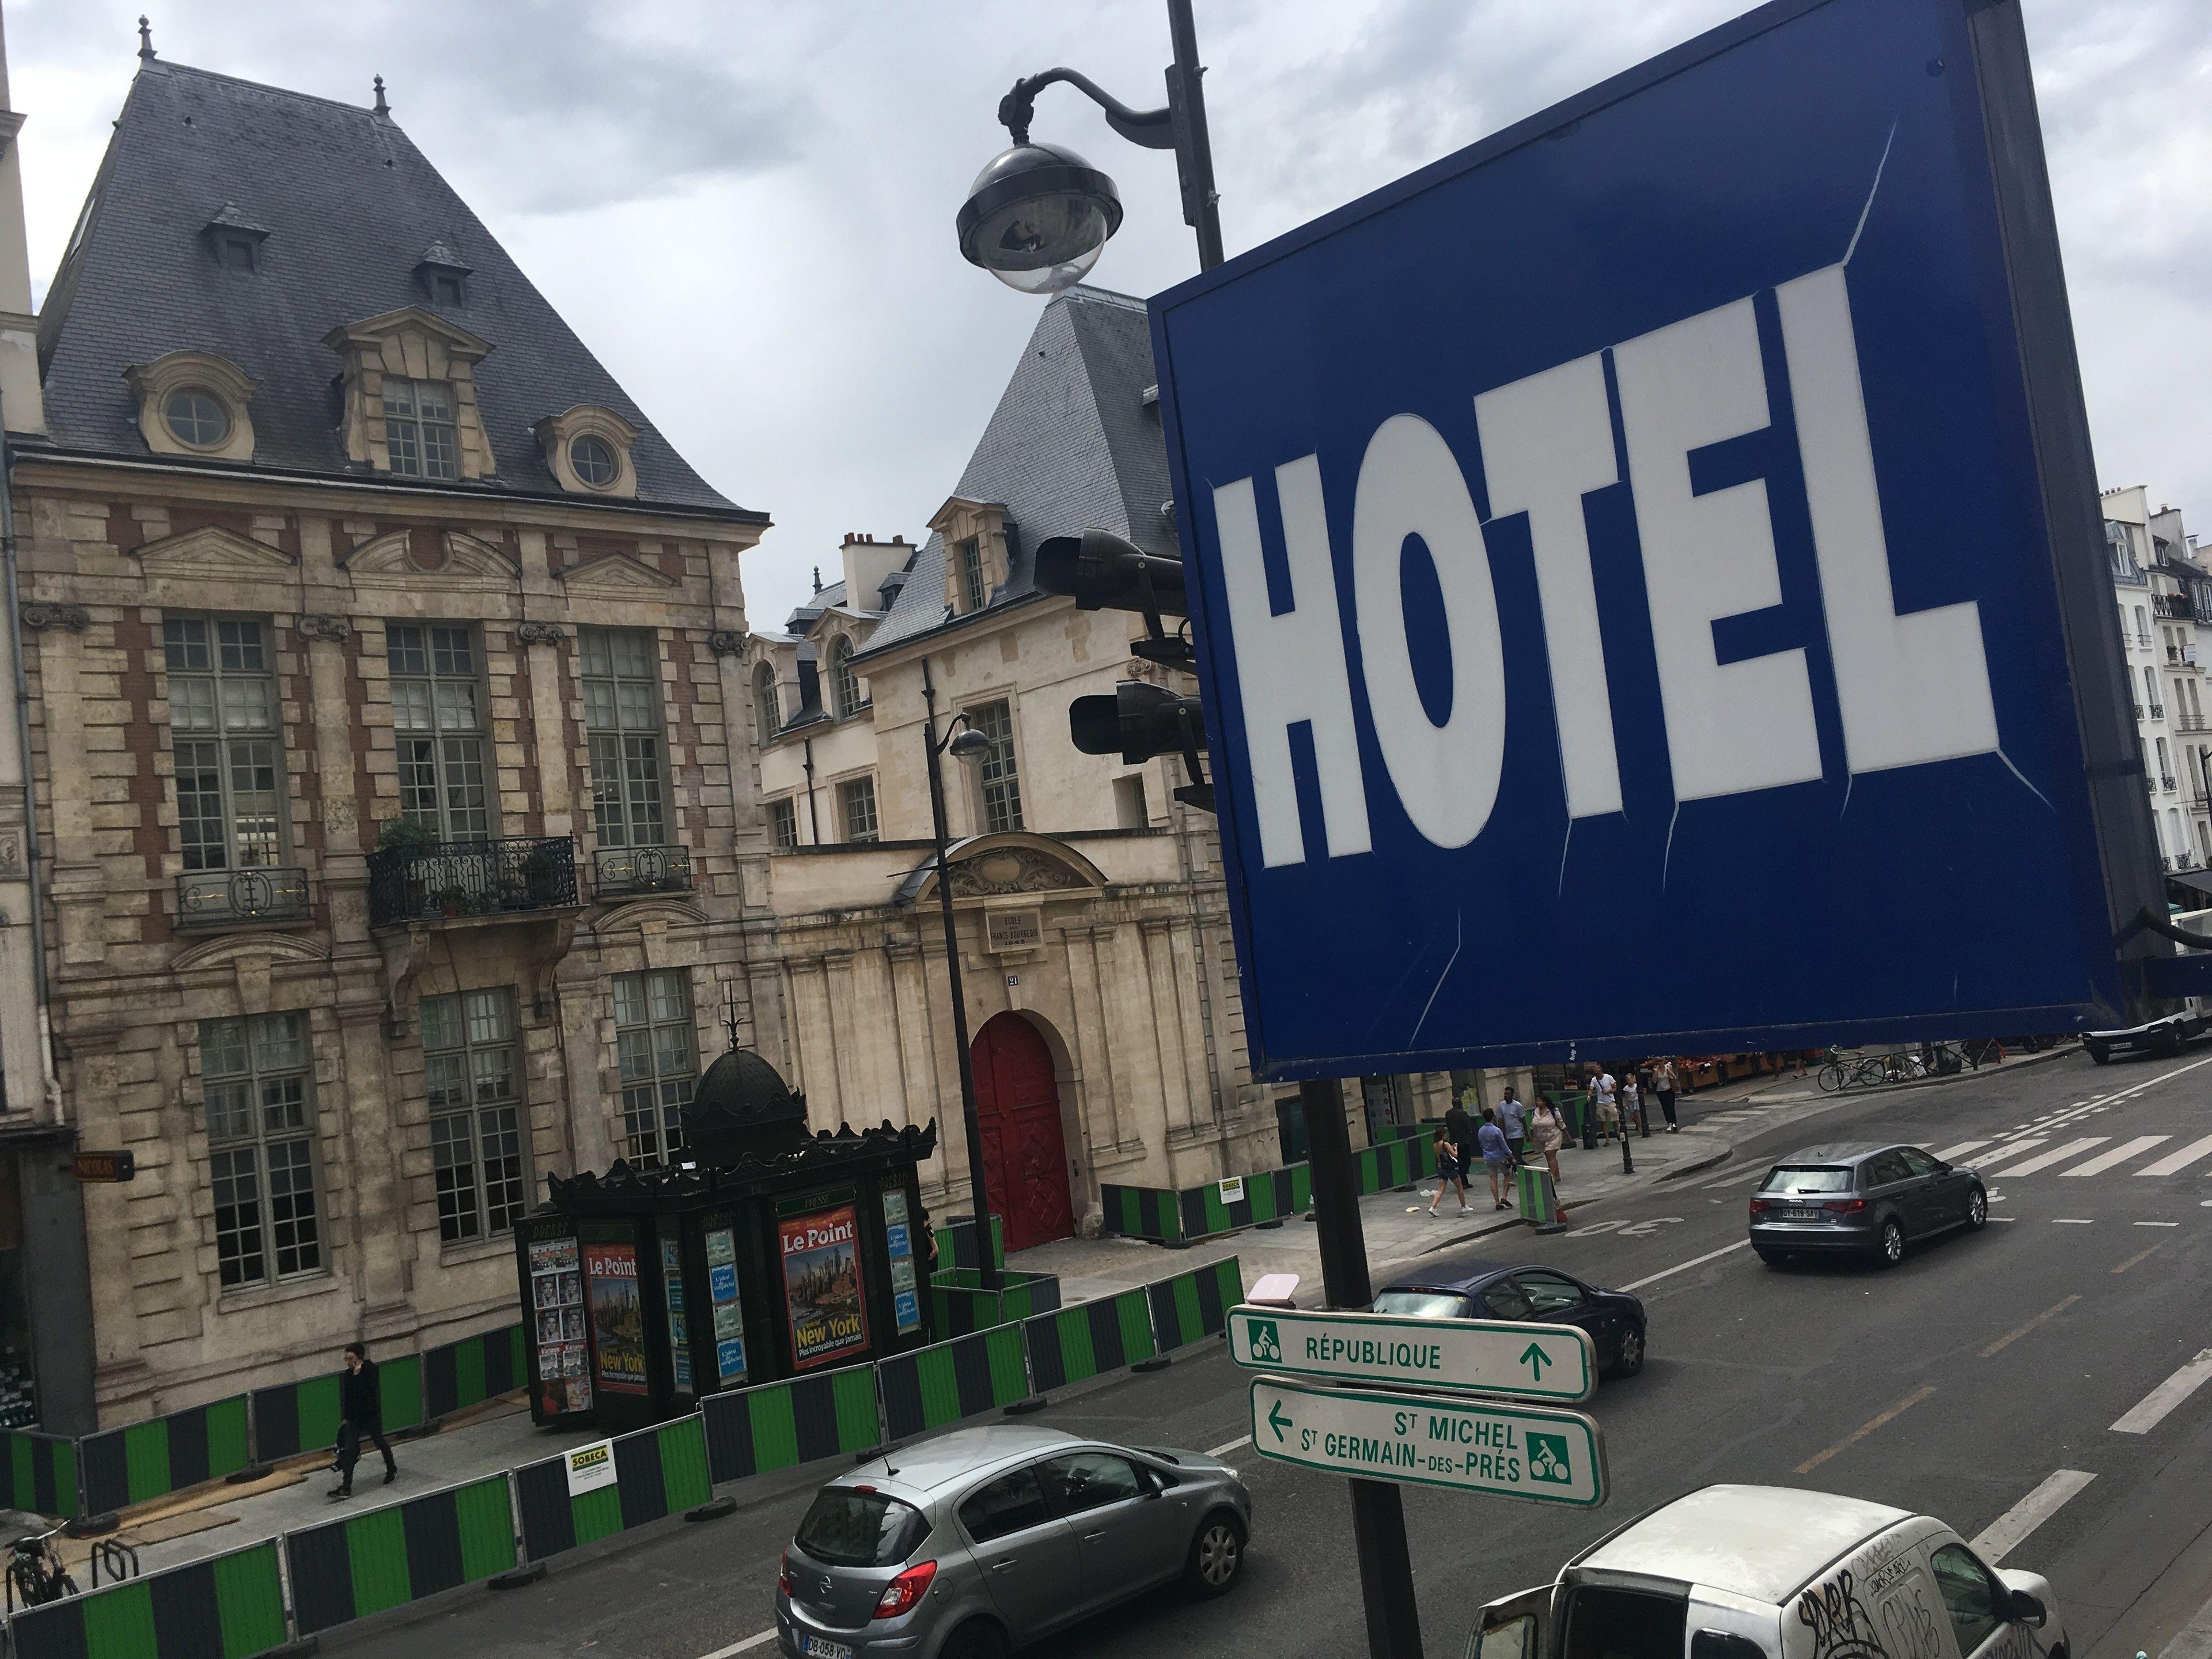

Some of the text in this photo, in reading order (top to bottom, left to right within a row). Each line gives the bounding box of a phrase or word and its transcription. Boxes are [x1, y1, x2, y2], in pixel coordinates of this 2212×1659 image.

[1213, 264, 1999, 869] HOTEL
[991, 929, 1039, 941] FRANCS BOURGEOIS
[1009, 976, 1017, 985] 21
[533, 1222, 569, 1238] PRESSE
[703, 1210, 733, 1229] PRESSE
[783, 1235, 804, 1253] Le
[807, 1221, 853, 1248] Point
[589, 1256, 637, 1276] Le Point
[796, 1313, 861, 1349] New York
[798, 1333, 862, 1357] Plus incroyable que jamais
[1306, 1332, 1441, 1370] RÉPUBLIQUE
[600, 1350, 644, 1373] New York
[1429, 1415, 1518, 1450] MICHEL
[572, 1449, 607, 1466] SOBECA
[1325, 1433, 1520, 1483] GERMAIN-DES-PRÉS
